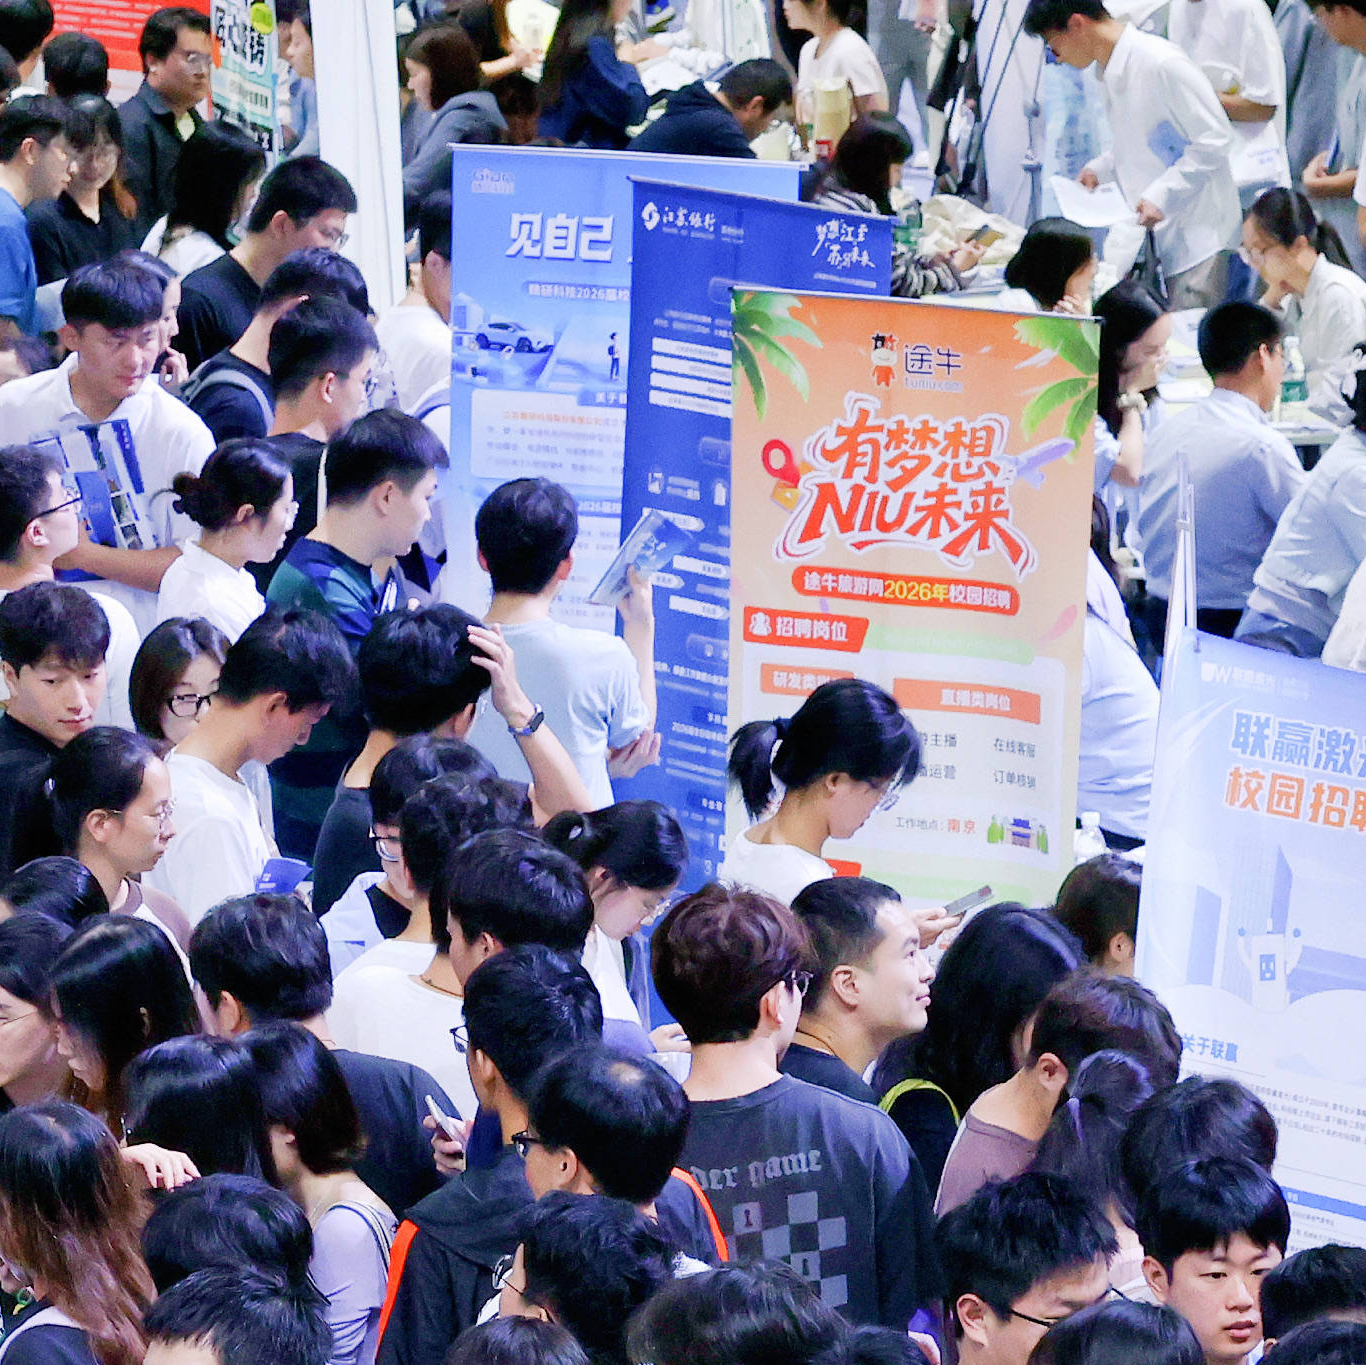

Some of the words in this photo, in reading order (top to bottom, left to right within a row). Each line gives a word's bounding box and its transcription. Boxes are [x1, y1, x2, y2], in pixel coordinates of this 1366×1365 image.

[505, 211, 614, 264] 见自己
[905, 344, 962, 375] 途牛
[822, 408, 1001, 492] 有梦想
[797, 481, 1024, 566] NIU未来
[804, 570, 1012, 609] 途牛旅游网2026年校园招聘
[776, 617, 848, 643] 招聘岗位
[940, 688, 1012, 712] 直播类岗位
[1182, 1033, 1239, 1063] 关于联赢
[747, 1149, 822, 1189] name
